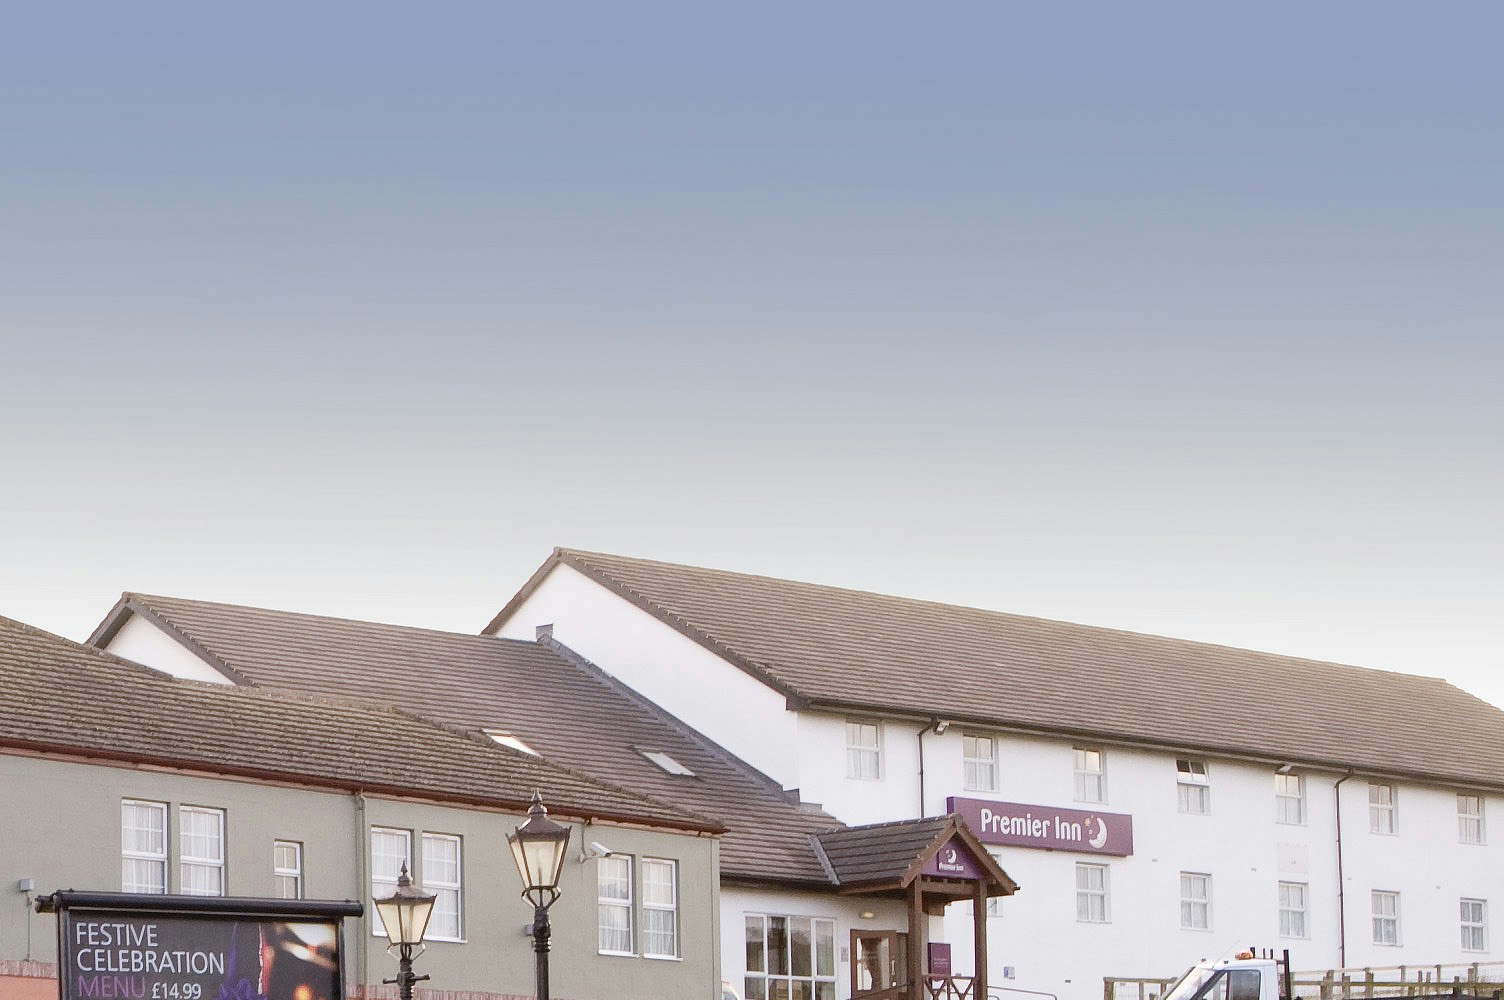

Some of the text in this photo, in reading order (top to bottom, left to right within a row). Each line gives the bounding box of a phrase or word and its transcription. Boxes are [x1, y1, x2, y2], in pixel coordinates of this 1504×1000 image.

[981, 808, 1081, 841] Premier Inn
[76, 922, 158, 947] FESTIVE
[77, 948, 224, 974] CELEBRATION
[78, 975, 202, 1000] MENU £14.99
